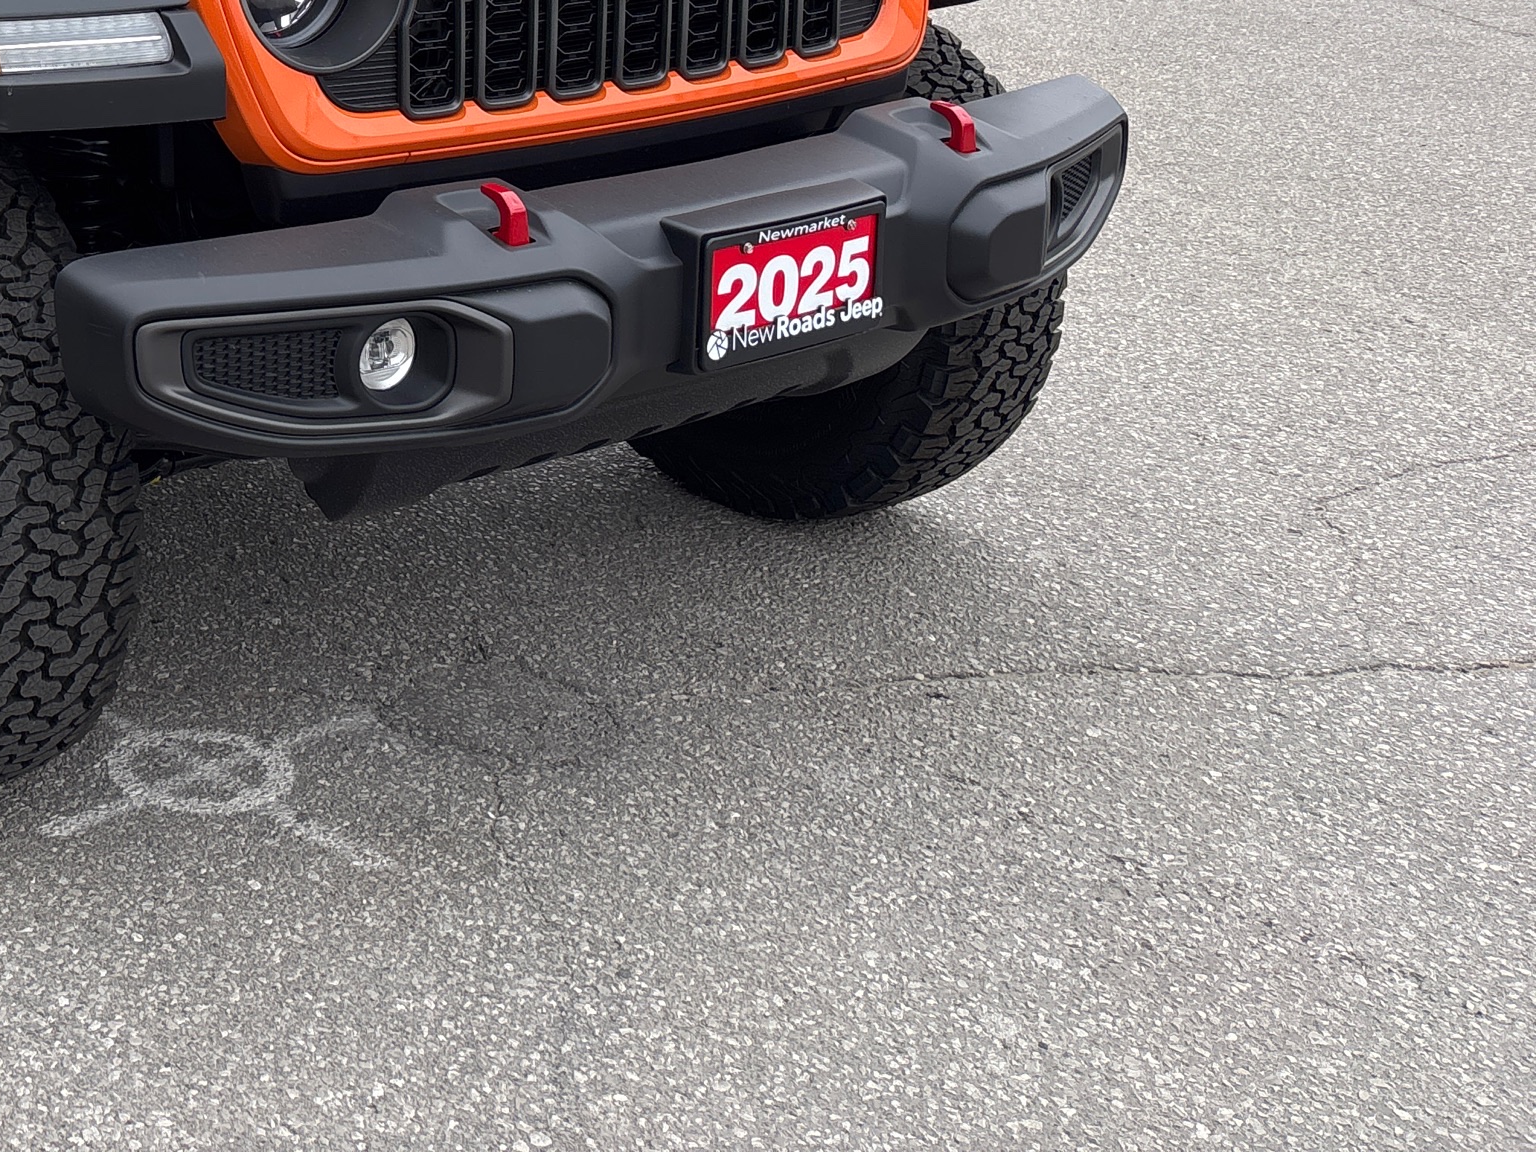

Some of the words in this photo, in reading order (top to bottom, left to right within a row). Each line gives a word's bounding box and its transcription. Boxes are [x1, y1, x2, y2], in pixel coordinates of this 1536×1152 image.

[758, 214, 846, 244] Newmarket
[715, 235, 870, 332] 2025
[840, 295, 883, 322] Jeep
